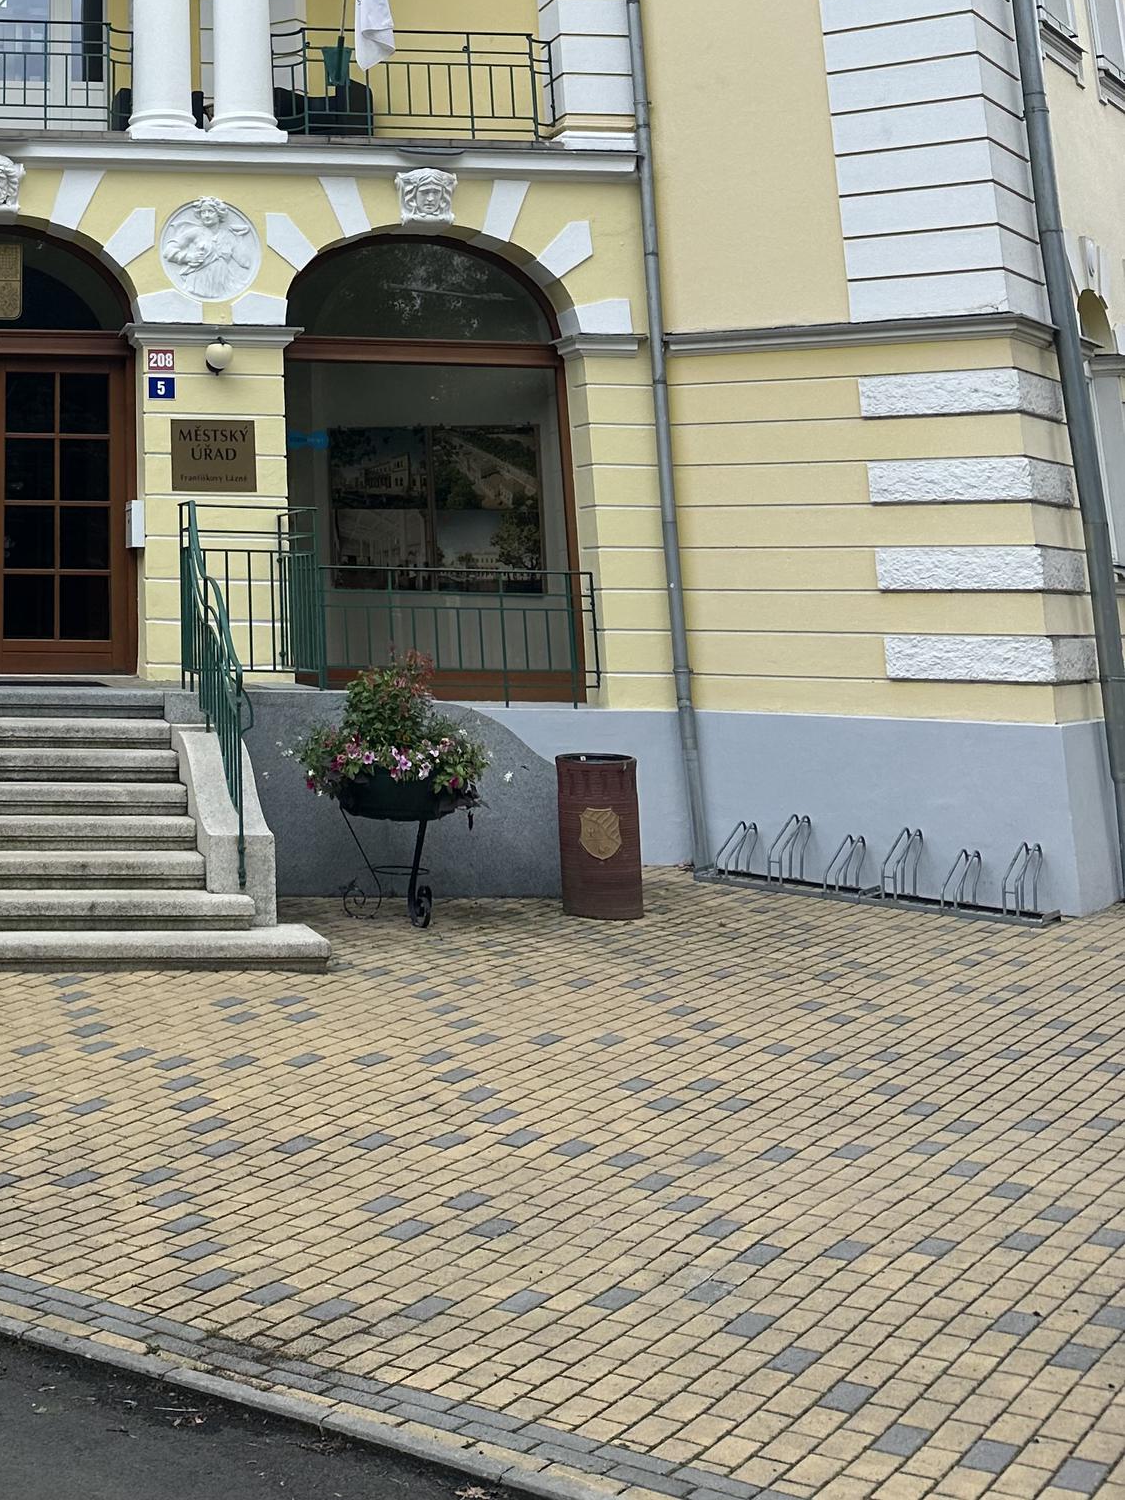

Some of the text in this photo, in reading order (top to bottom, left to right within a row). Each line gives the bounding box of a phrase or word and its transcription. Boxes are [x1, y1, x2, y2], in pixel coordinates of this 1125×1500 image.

[149, 353, 173, 368] 208
[157, 381, 166, 395] 5
[178, 425, 249, 442] MĚSTSKÝ
[191, 443, 237, 461] ÚŘAD
